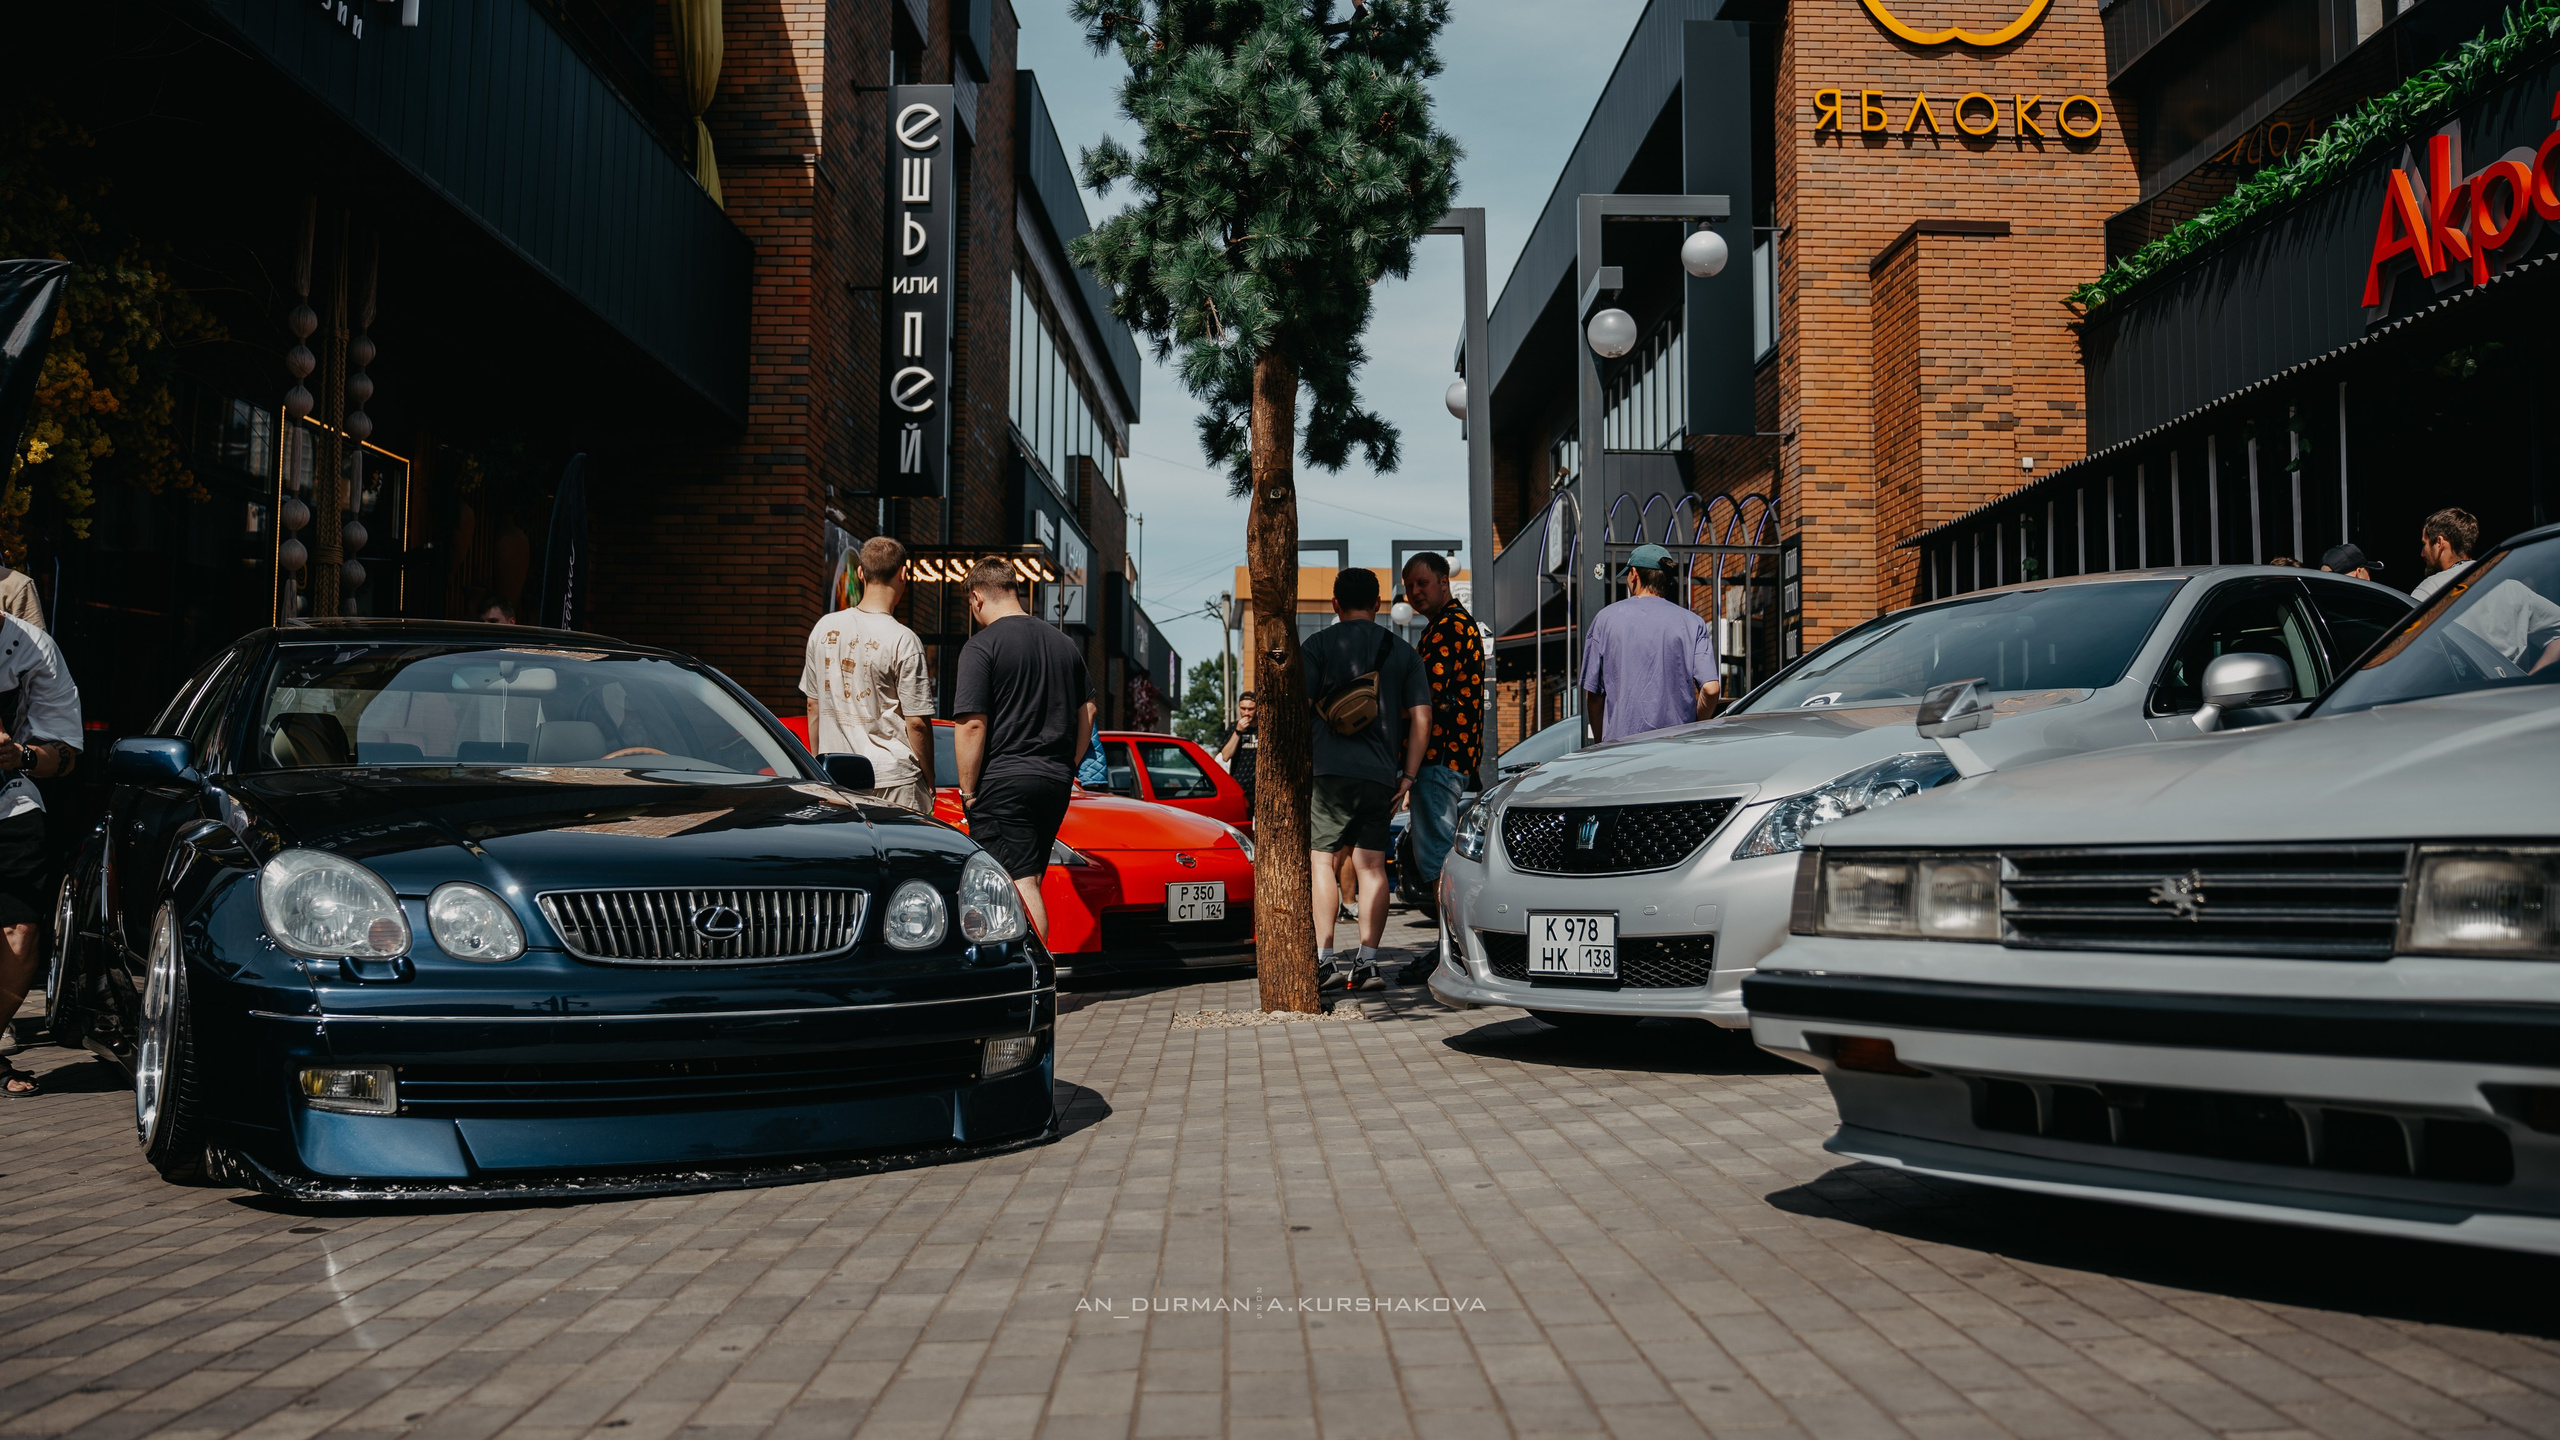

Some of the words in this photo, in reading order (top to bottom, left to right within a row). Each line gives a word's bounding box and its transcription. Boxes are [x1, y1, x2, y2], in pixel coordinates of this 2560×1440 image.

[1813, 88, 2103, 138] ЯБЛОКО
[892, 276, 938, 294] или
[1192, 885, 1215, 901] 350
[1178, 903, 1196, 919] СТ
[1205, 903, 1222, 917] 124
[1564, 918, 1599, 942] 978
[1542, 947, 1568, 971] НК
[1585, 948, 1612, 968] 138
